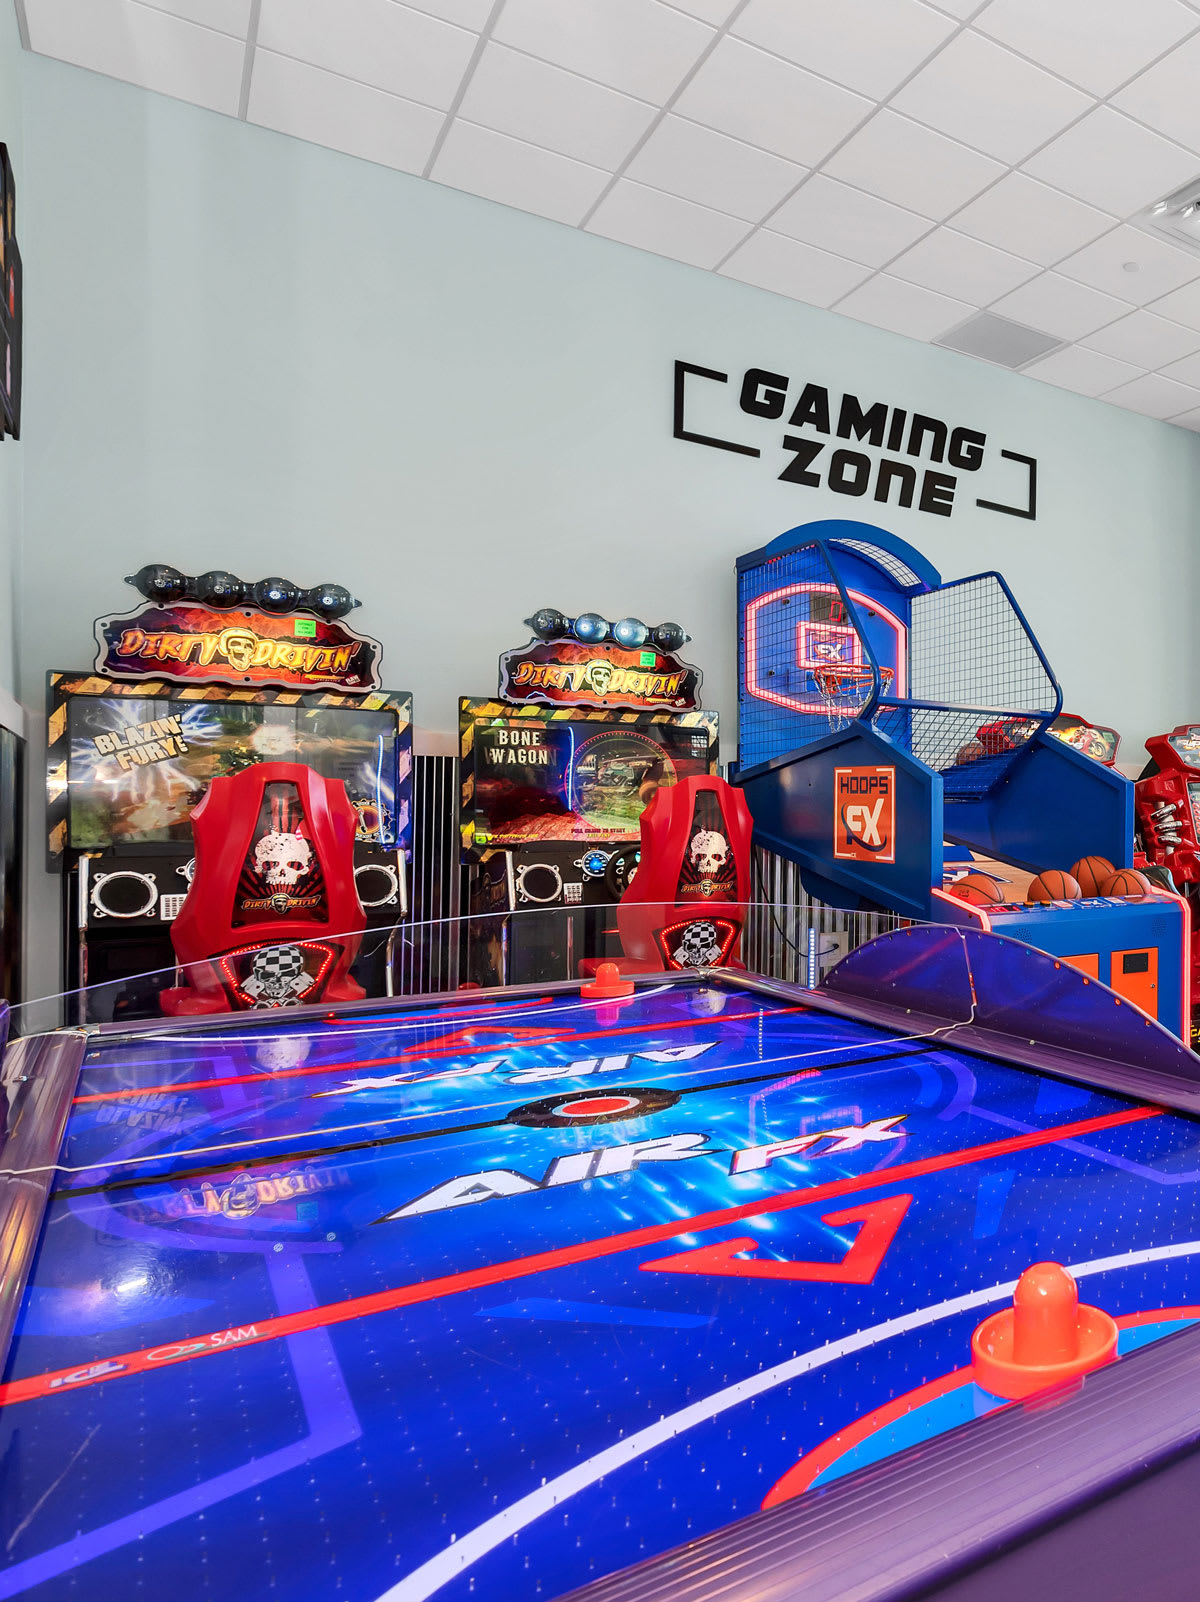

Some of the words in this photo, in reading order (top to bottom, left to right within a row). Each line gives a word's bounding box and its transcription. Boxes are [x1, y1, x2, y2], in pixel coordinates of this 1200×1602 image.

[739, 367, 987, 472] GAMING
[777, 434, 957, 518] ZONE
[117, 628, 219, 665] DIRTY
[254, 640, 362, 673] DRIVIN'
[514, 660, 588, 692] DIRTY
[606, 669, 689, 698] DRIVIN'
[93, 714, 183, 756] BLAZIN'
[489, 748, 548, 765] WAGON
[498, 729, 541, 746] BONE
[840, 776, 888, 794] HOOPS
[846, 798, 885, 847] FX
[504, 1041, 722, 1085] AIR
[369, 1133, 728, 1225] AIR
[729, 1114, 914, 1176] FX
[210, 1325, 258, 1348] SAM
